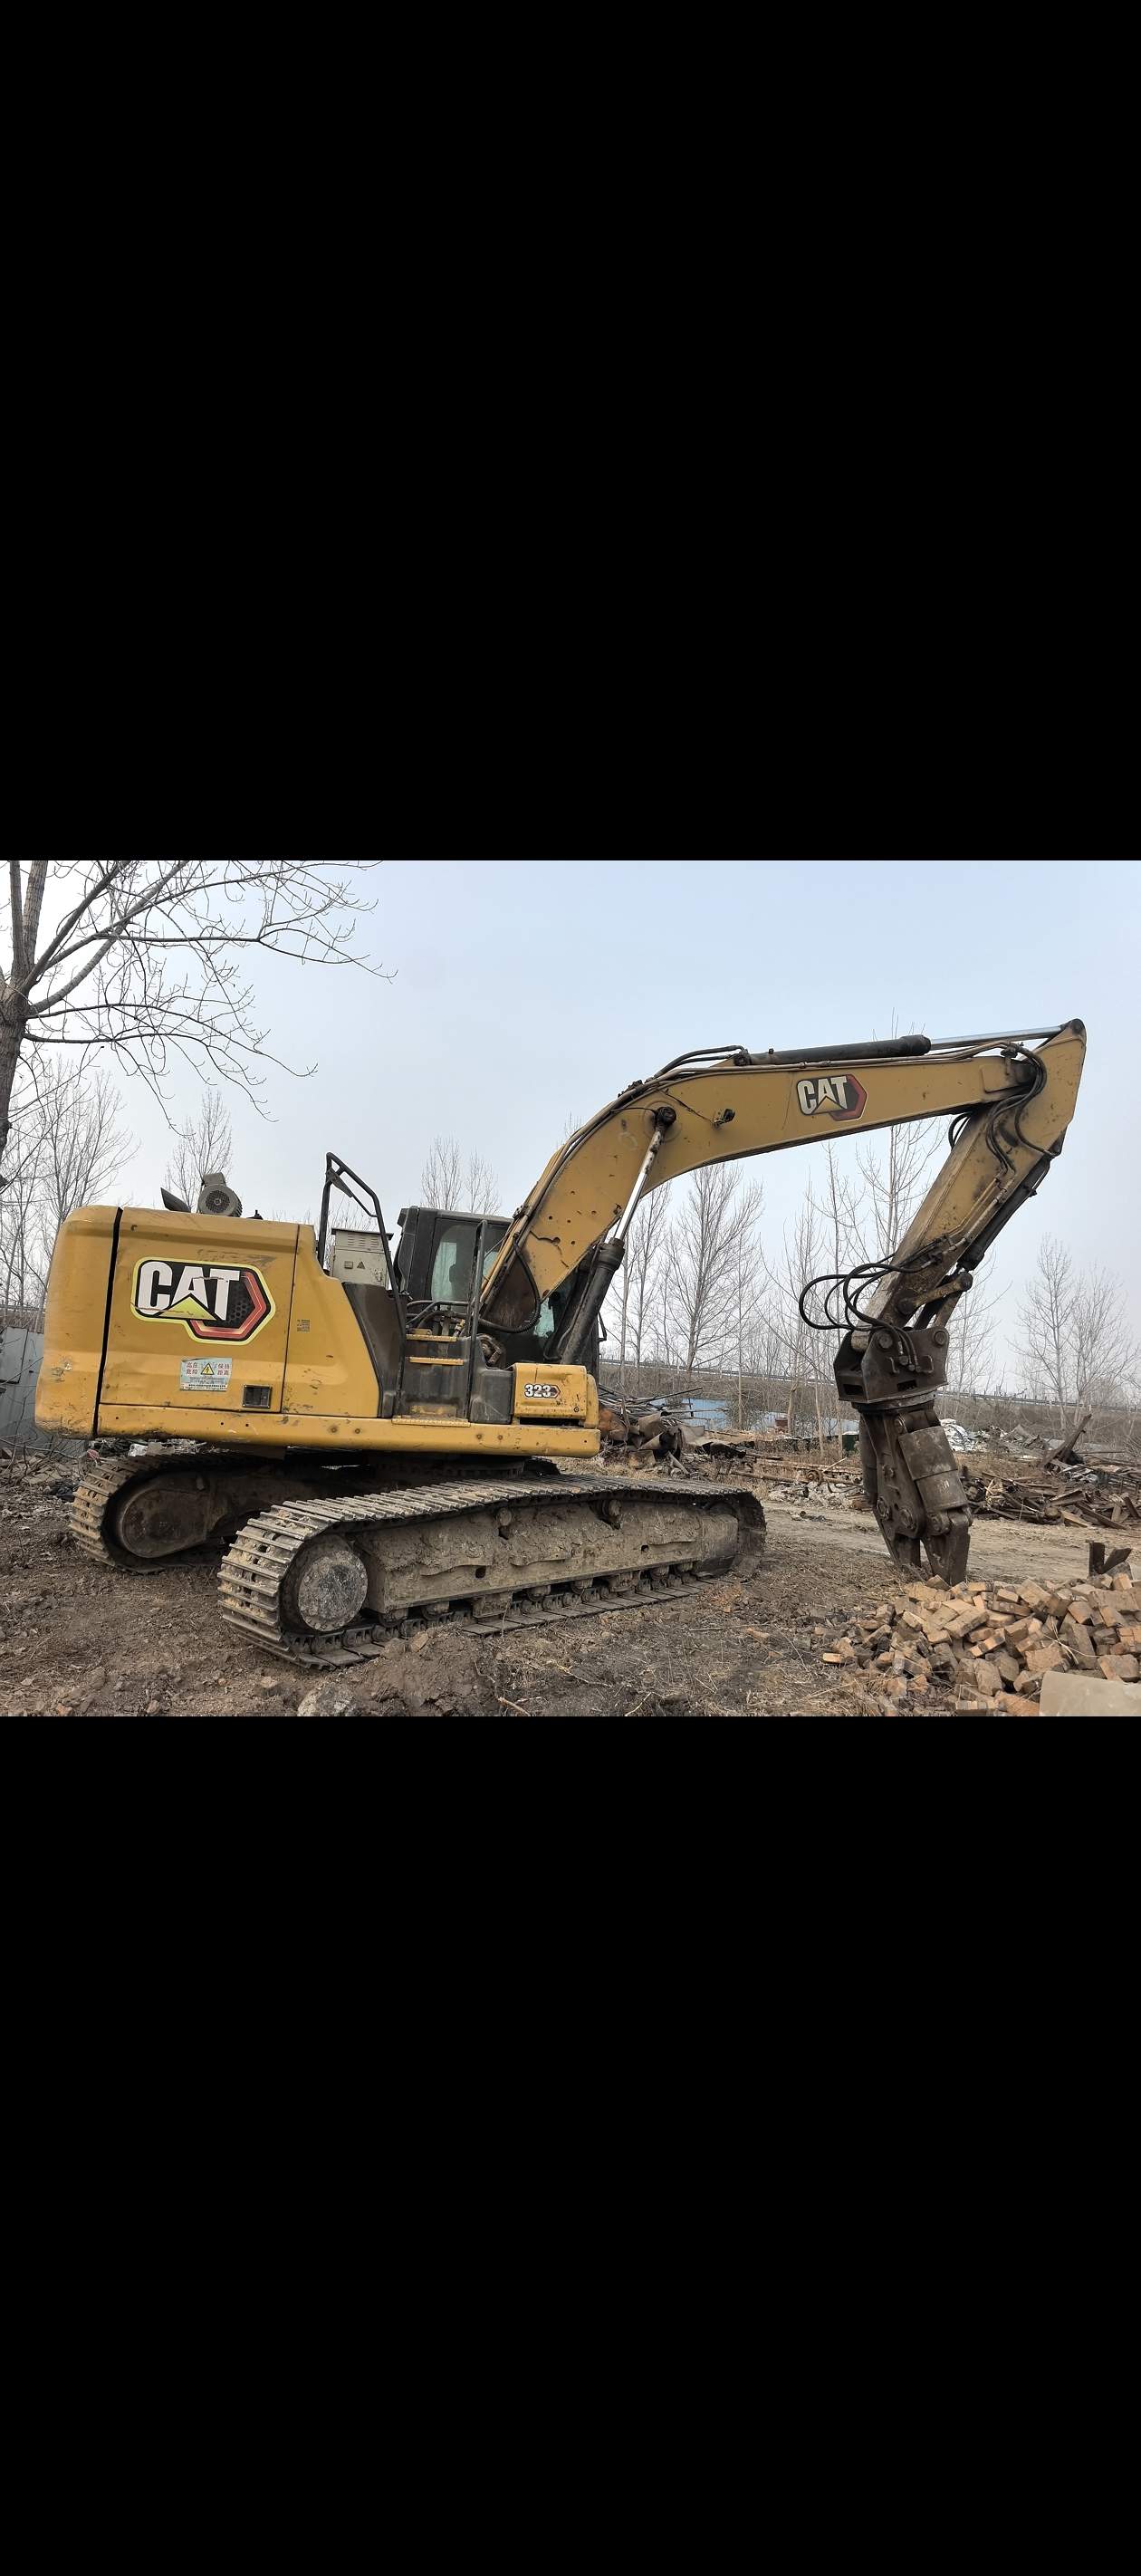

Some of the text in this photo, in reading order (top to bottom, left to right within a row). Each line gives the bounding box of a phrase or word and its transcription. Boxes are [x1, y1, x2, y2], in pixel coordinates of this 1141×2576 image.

[797, 1075, 848, 1115] CAT
[137, 1261, 240, 1322] CAT
[524, 1383, 551, 1398] 323
